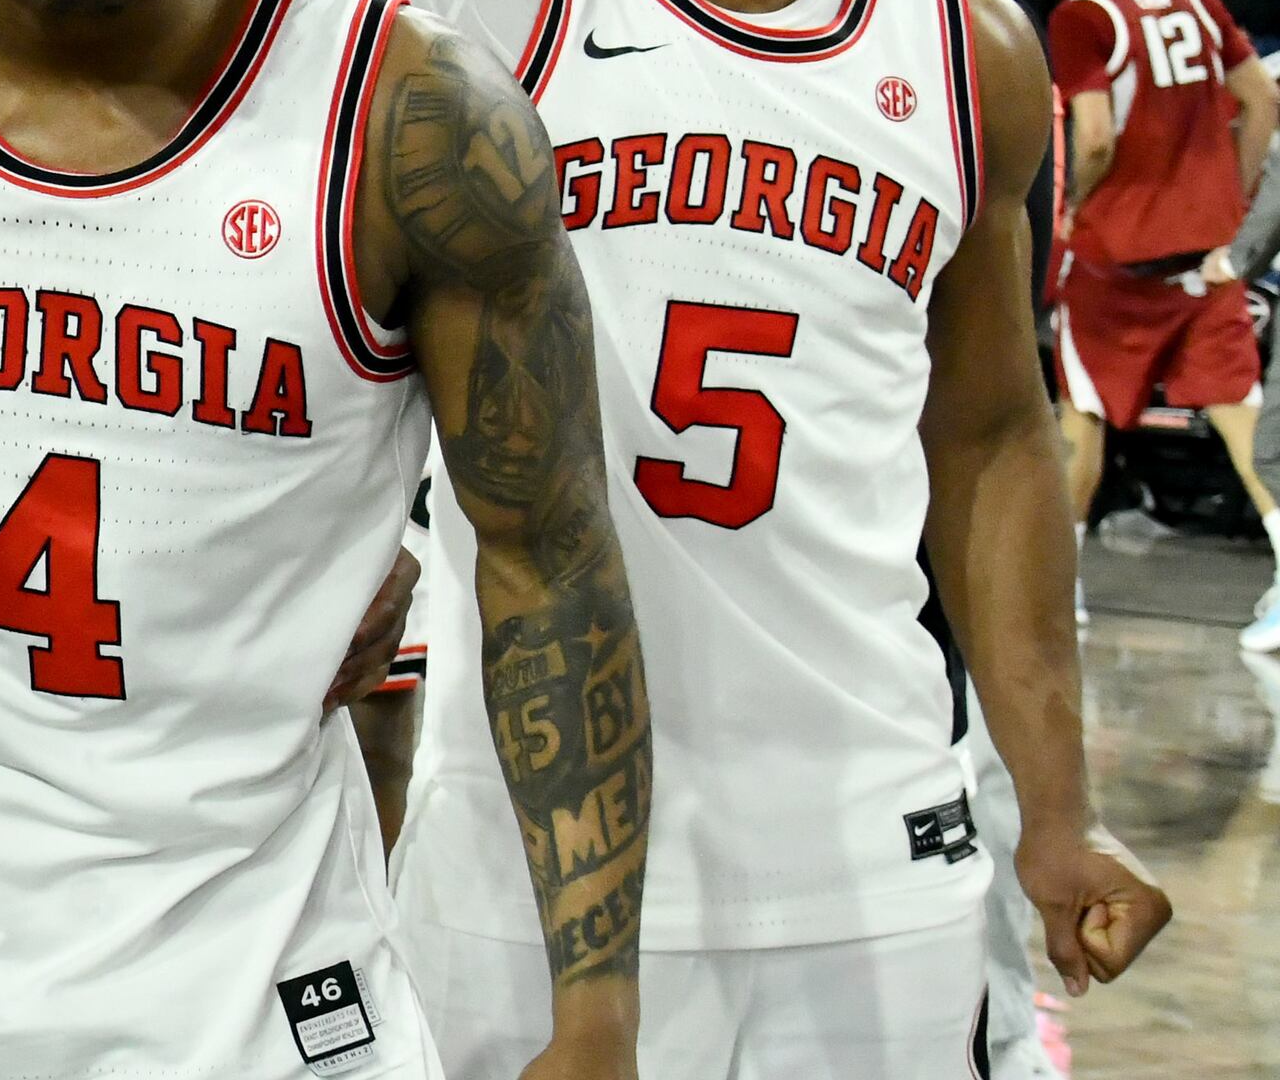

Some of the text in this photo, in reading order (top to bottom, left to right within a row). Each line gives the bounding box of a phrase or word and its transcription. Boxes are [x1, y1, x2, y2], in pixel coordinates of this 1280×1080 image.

[1140, 10, 1208, 89] 12
[879, 80, 913, 118] SEC
[228, 205, 276, 253] SEC
[552, 132, 941, 303] GEORGIA
[633, 300, 800, 531] 5
[301, 977, 343, 1007] 46
